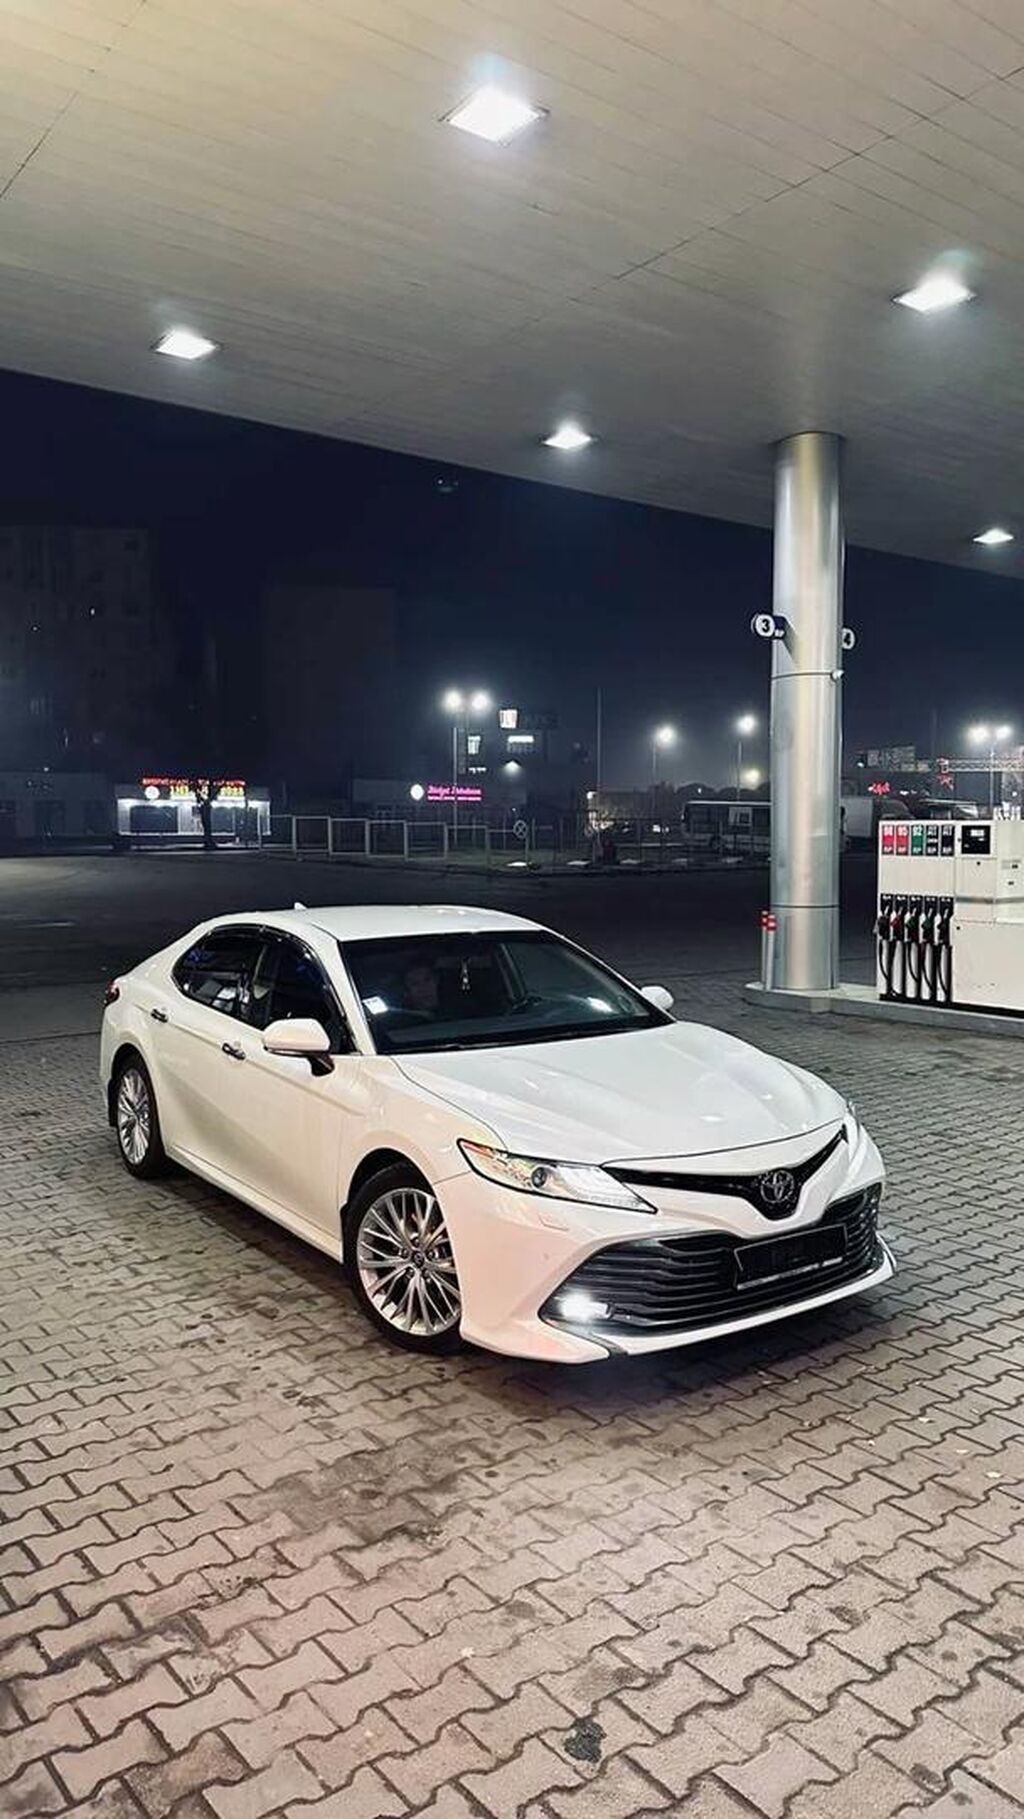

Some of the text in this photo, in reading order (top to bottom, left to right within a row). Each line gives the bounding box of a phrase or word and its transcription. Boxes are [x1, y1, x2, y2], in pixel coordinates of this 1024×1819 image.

[762, 619, 770, 632] 3
[843, 633, 851, 646] 4
[912, 826, 922, 836] 92
